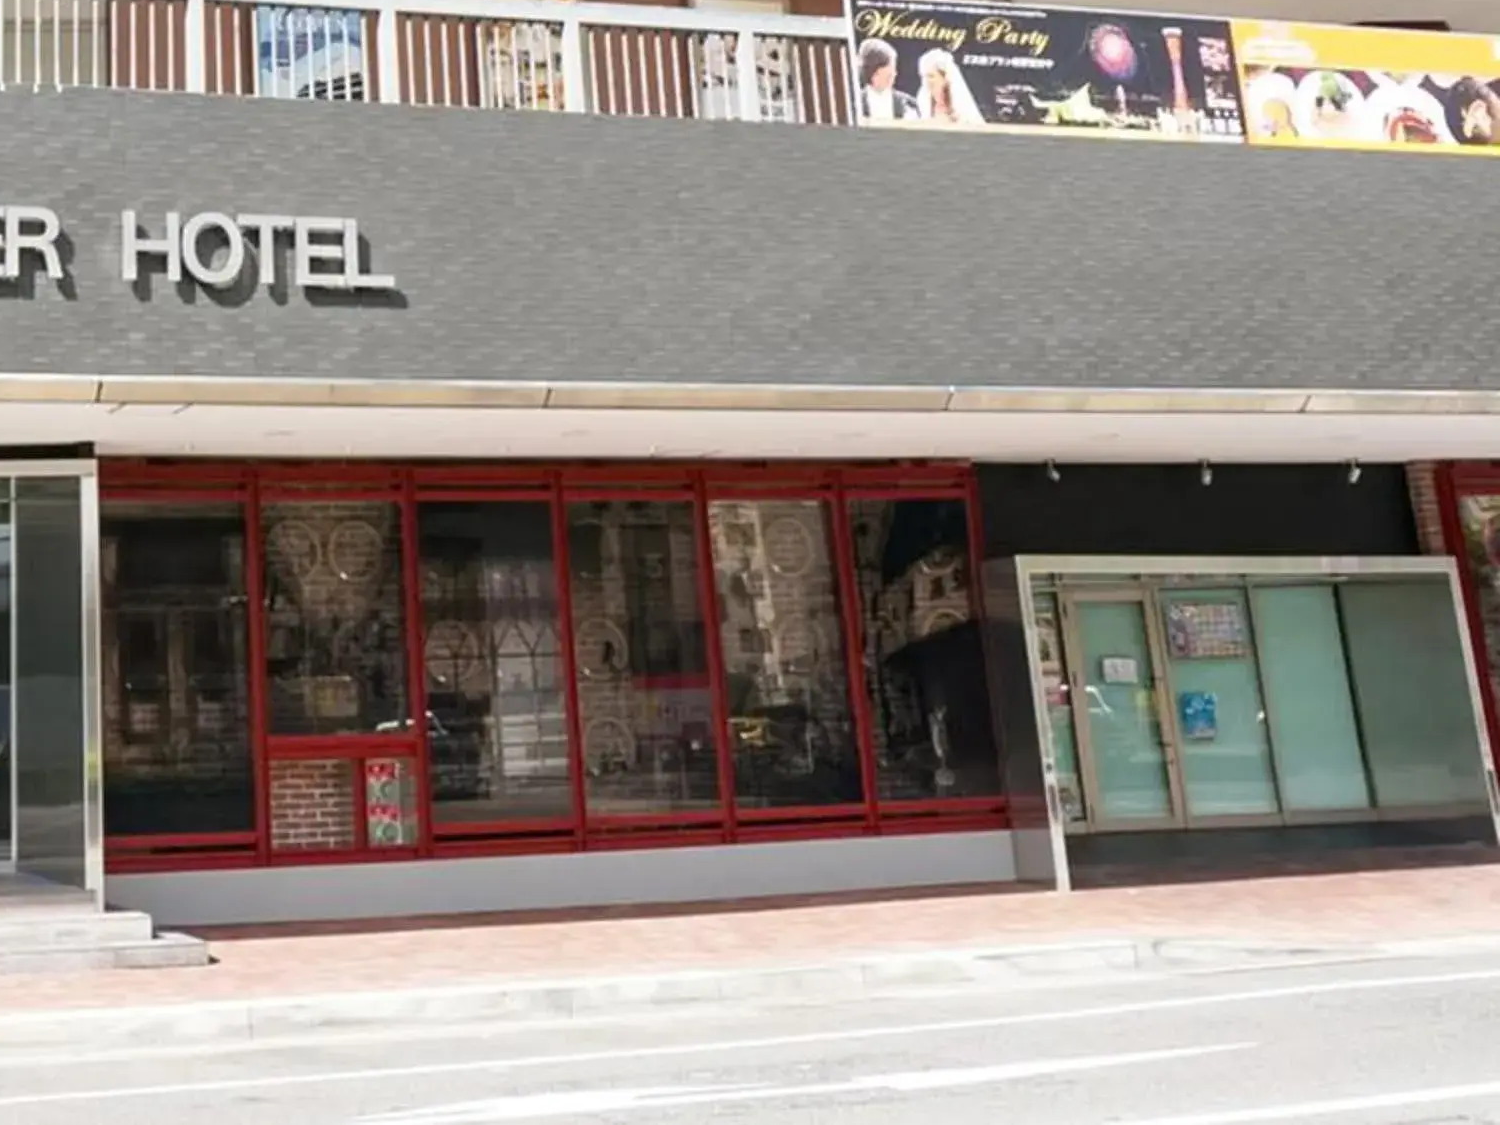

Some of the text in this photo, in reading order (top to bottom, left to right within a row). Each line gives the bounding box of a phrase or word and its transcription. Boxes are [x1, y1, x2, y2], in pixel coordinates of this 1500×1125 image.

[855, 8, 967, 51] Wedding
[975, 16, 1051, 54] Party
[121, 209, 396, 289] HOTEL
